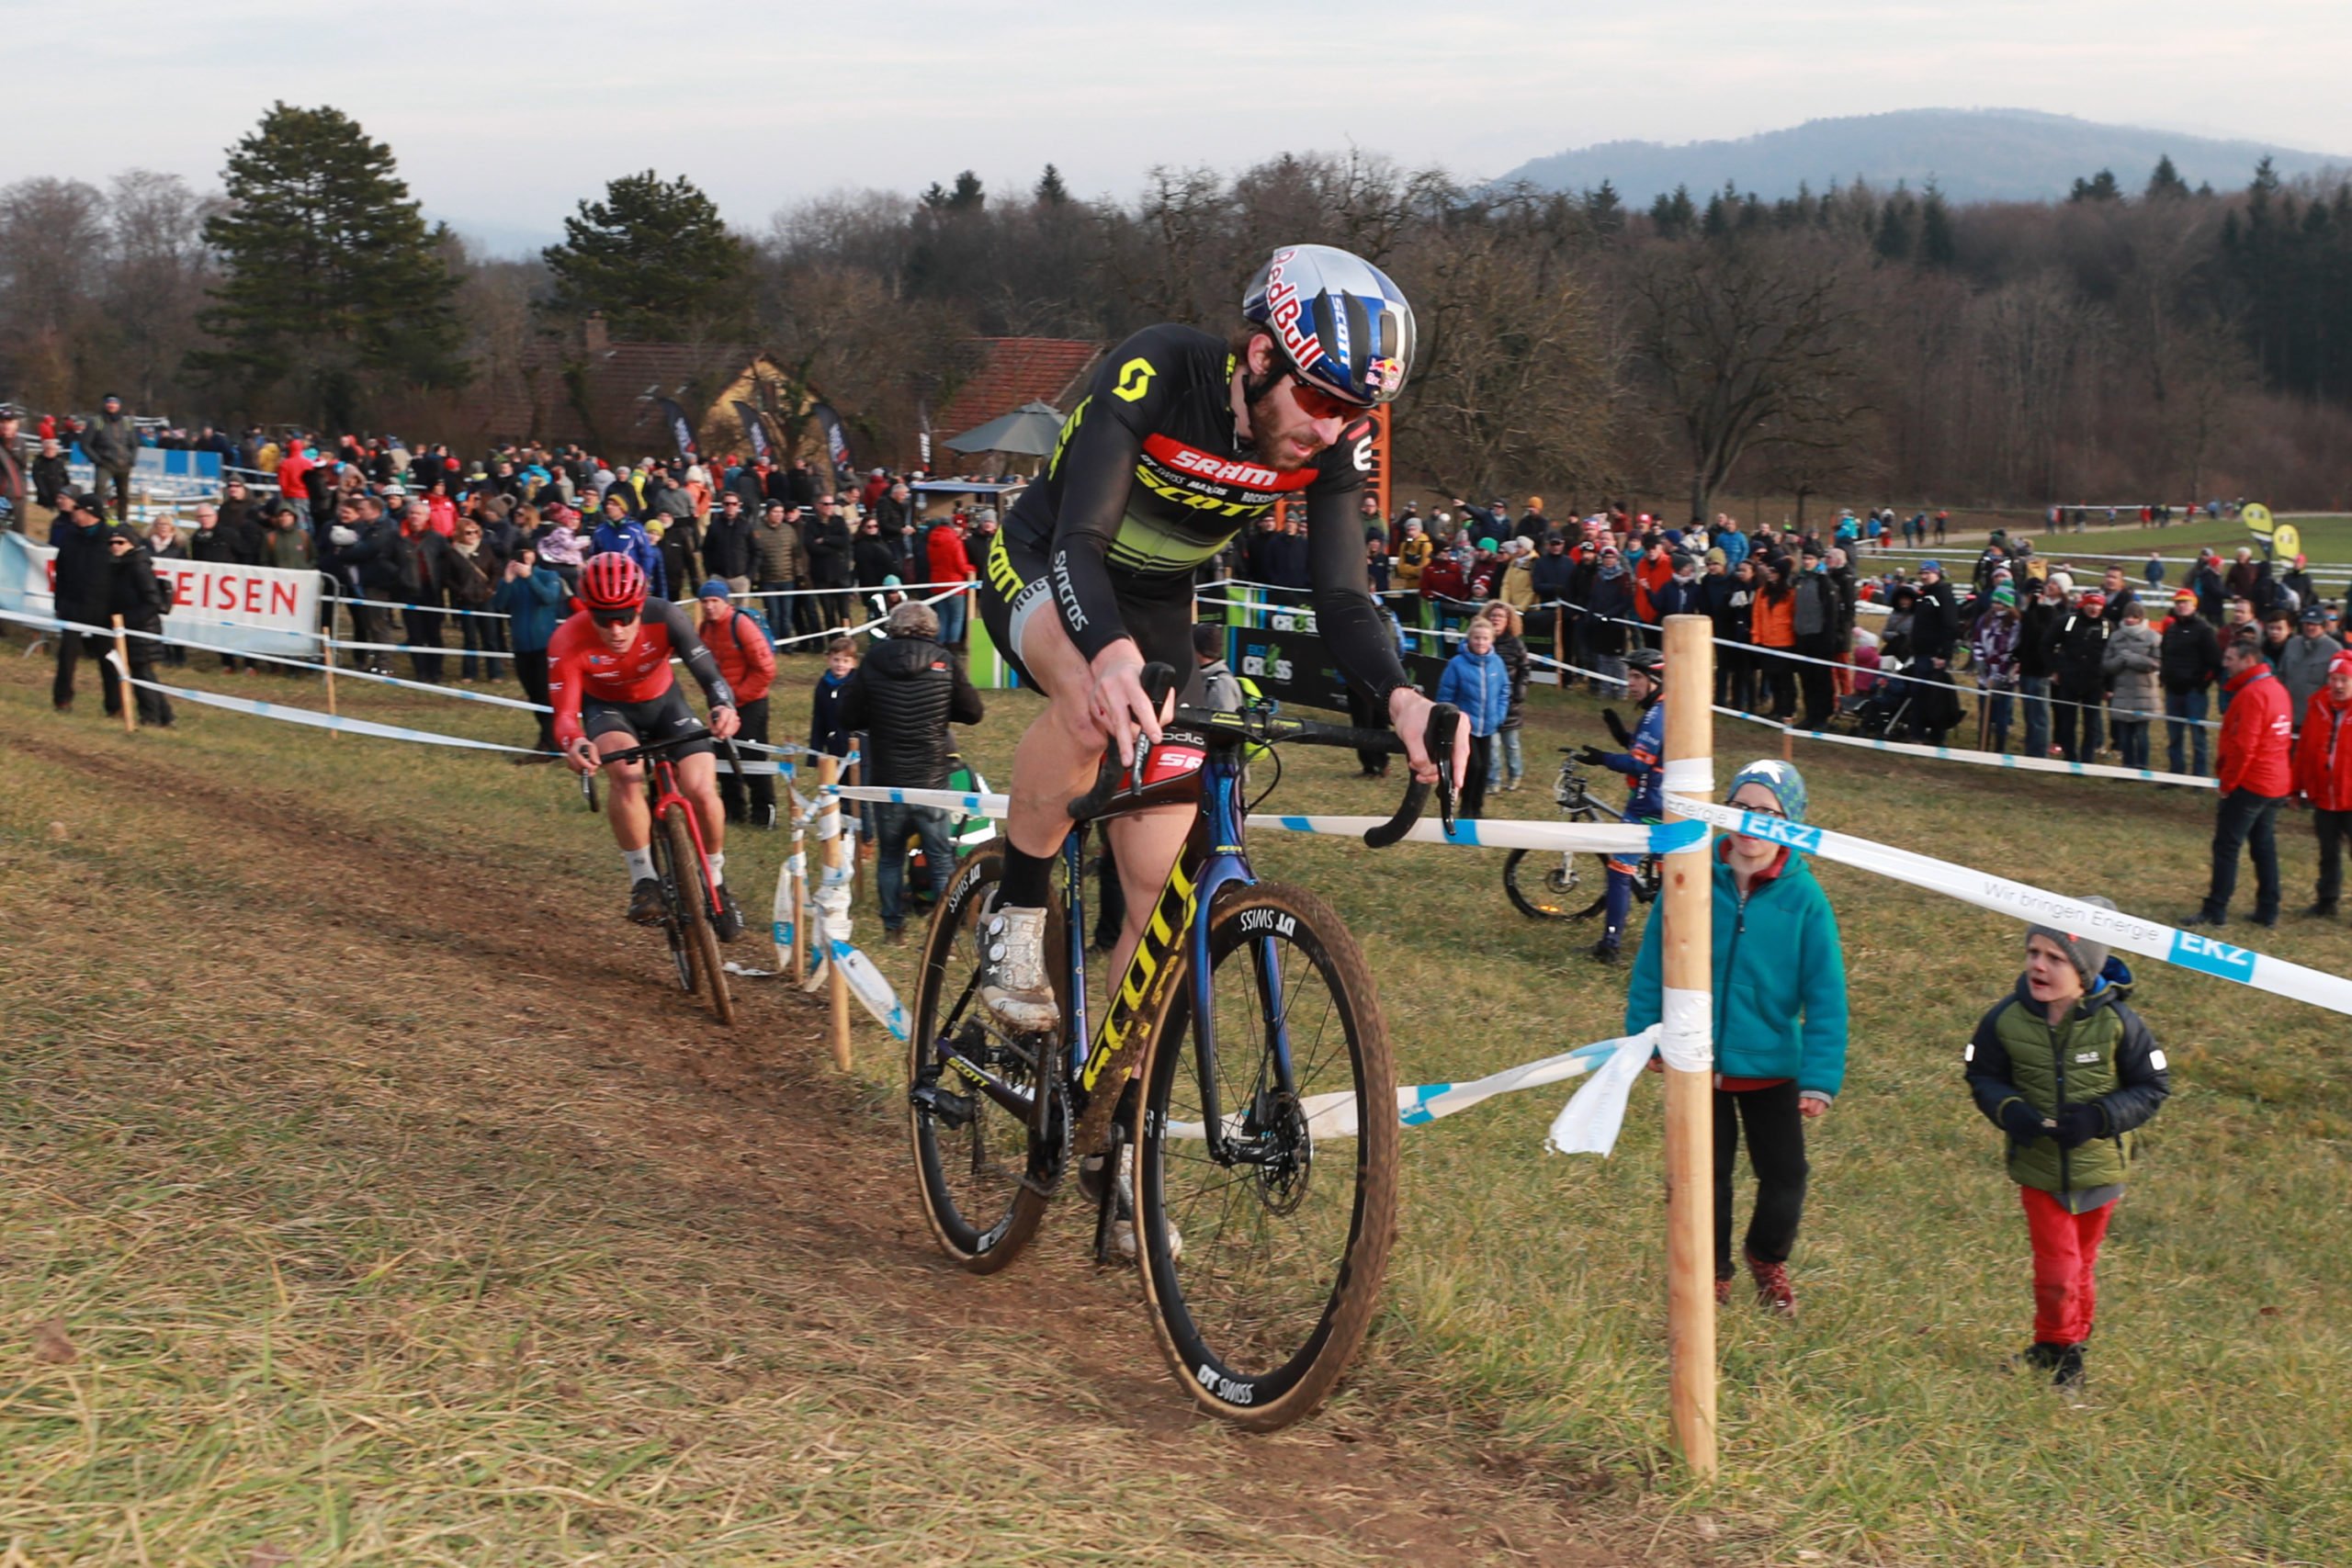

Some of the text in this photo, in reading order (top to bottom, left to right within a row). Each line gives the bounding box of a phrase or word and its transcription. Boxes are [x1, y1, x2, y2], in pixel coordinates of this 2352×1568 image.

[1272, 294, 1327, 372] Bull
[1331, 294, 1351, 370] SCOTT
[1135, 464, 1276, 517] SCOTT
[1154, 466, 1187, 485] SWISS
[1169, 449, 1279, 487] SRAM
[1746, 816, 1813, 848] EKZ
[948, 863, 981, 914] DT SWISS
[1239, 908, 1297, 938] DT SWISS
[1984, 880, 2250, 966] Wir bringen Energie EKZ
[1196, 1363, 1255, 1404] DT SWISS
